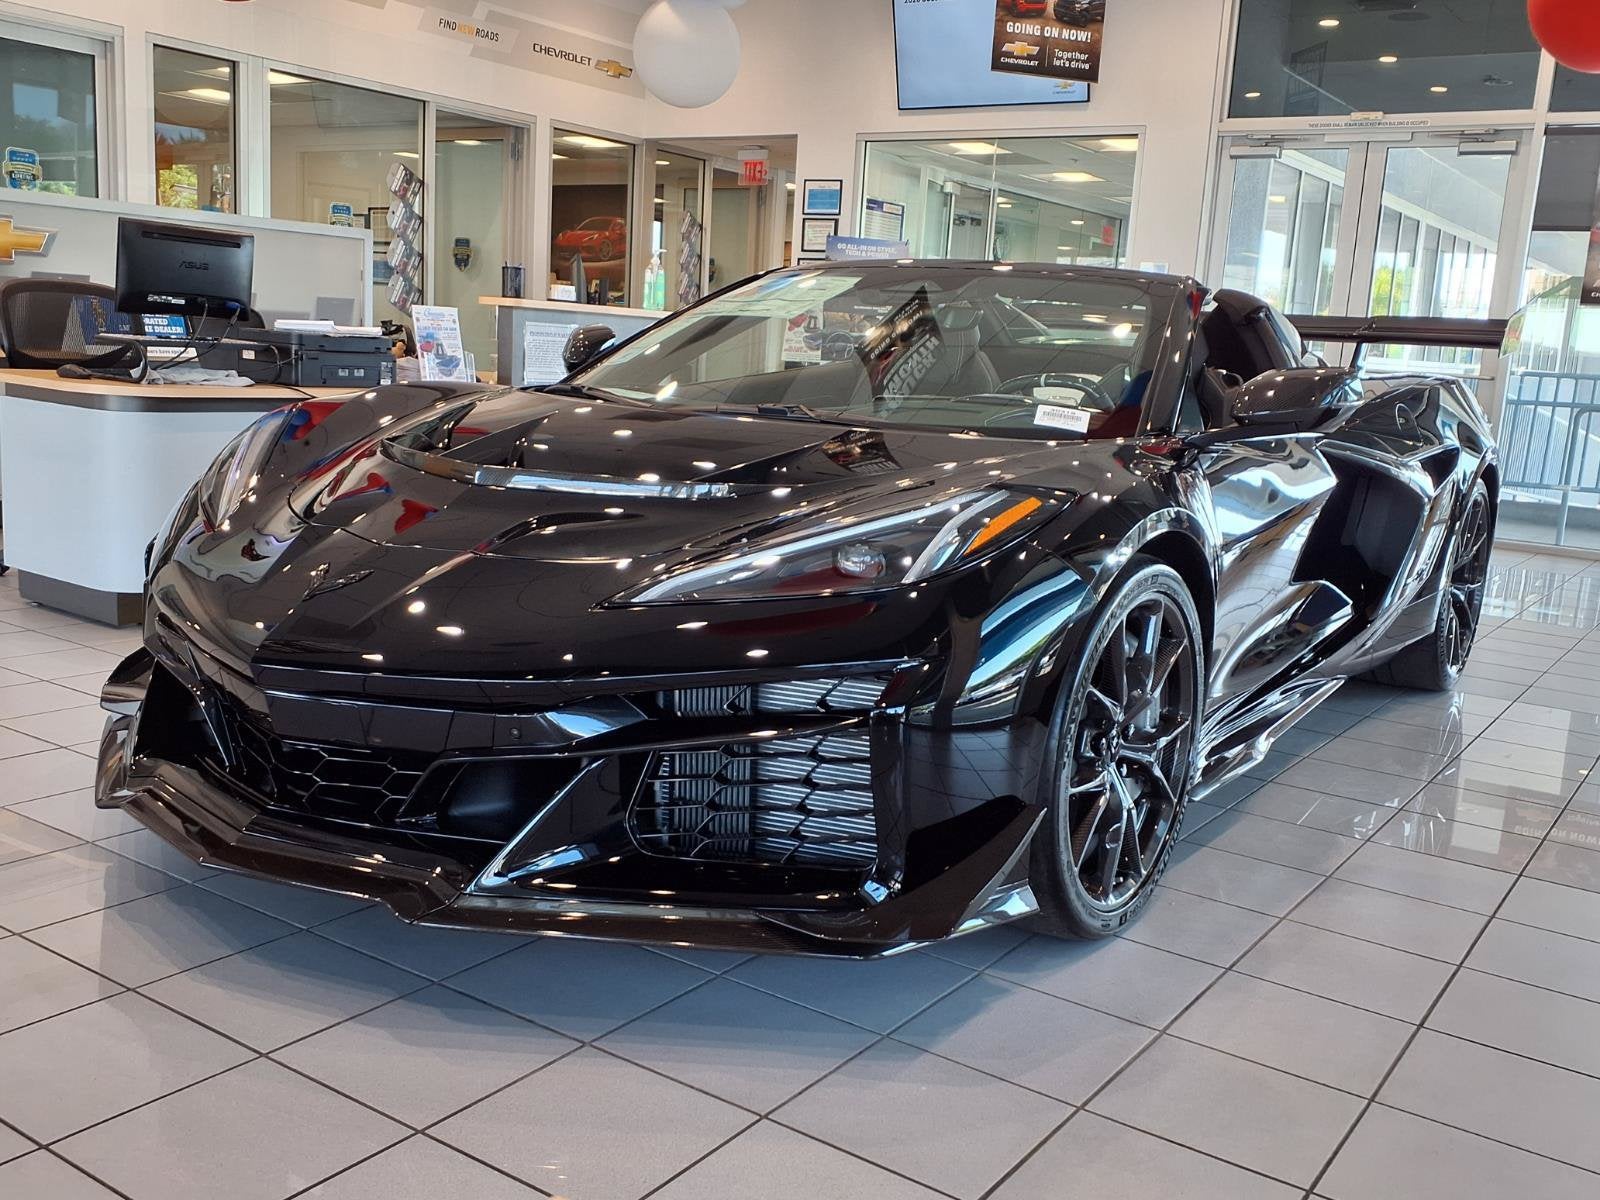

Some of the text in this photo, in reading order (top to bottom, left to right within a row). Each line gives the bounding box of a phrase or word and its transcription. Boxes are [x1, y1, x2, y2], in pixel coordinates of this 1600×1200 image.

[438, 18, 457, 31] FIND
[475, 27, 500, 42] ROADS
[1006, 21, 1092, 43] GOING ON NOW!
[532, 42, 593, 67] CHEVROLET
[1054, 48, 1089, 61] Together
[1000, 56, 1040, 67] CHEVROLET
[1053, 58, 1090, 70] let's drive
[179, 260, 209, 271] ASUS
